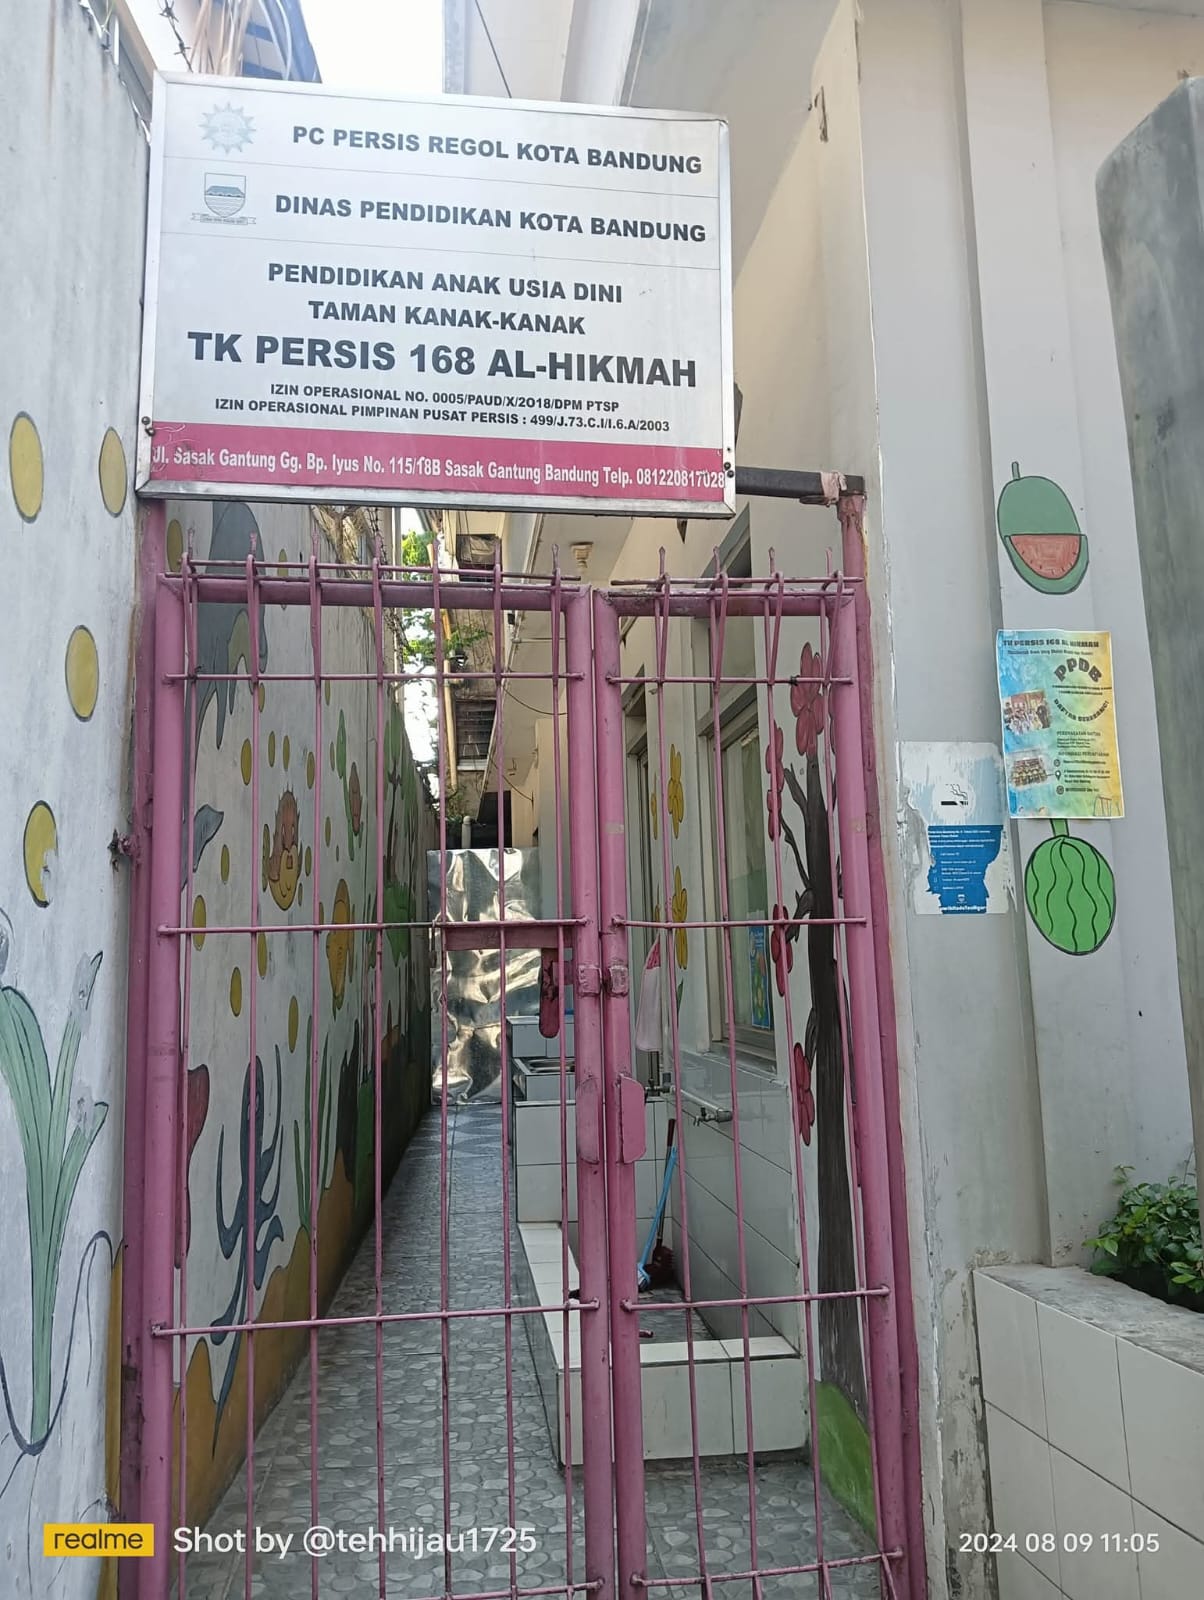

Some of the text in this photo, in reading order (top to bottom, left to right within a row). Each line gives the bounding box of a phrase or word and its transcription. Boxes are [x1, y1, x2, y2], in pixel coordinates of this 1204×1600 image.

[294, 126, 701, 173] PC PERSIS REGOL KOTA BANDUNG
[276, 195, 705, 242] DINAS PENDIDIKAN KOTA BANDUNG
[269, 263, 621, 303] PENDIDIKAN ANAK USIA DINI
[308, 301, 585, 334] TAMAN KANAK-KANAK
[188, 332, 695, 387] TK PERSIS 168 AL-HIKMAH
[216, 399, 243, 410] IZIN
[249, 400, 347, 415] OPERASIONAL
[352, 406, 418, 419] PIMPINAN
[424, 409, 467, 421] PUSAT
[472, 412, 518, 424] PERSIS
[271, 384, 298, 395] IZIN
[304, 386, 401, 400] OPERASIONAL
[406, 391, 428, 402] NO.
[587, 401, 619, 412] PTSP
[153, 446, 169, 463] Jl.
[174, 447, 215, 465] Sasak
[220, 449, 275, 472] Gantung
[280, 452, 301, 473] Gg.
[307, 453, 327, 474] Bp.
[333, 454, 359, 475] Iyus
[364, 456, 384, 472] No.
[445, 460, 483, 477] Sasak
[488, 462, 540, 484] Gantung
[546, 464, 598, 487] Bandung
[603, 467, 632, 488] Telp.
[637, 468, 726, 488] 081220817028
